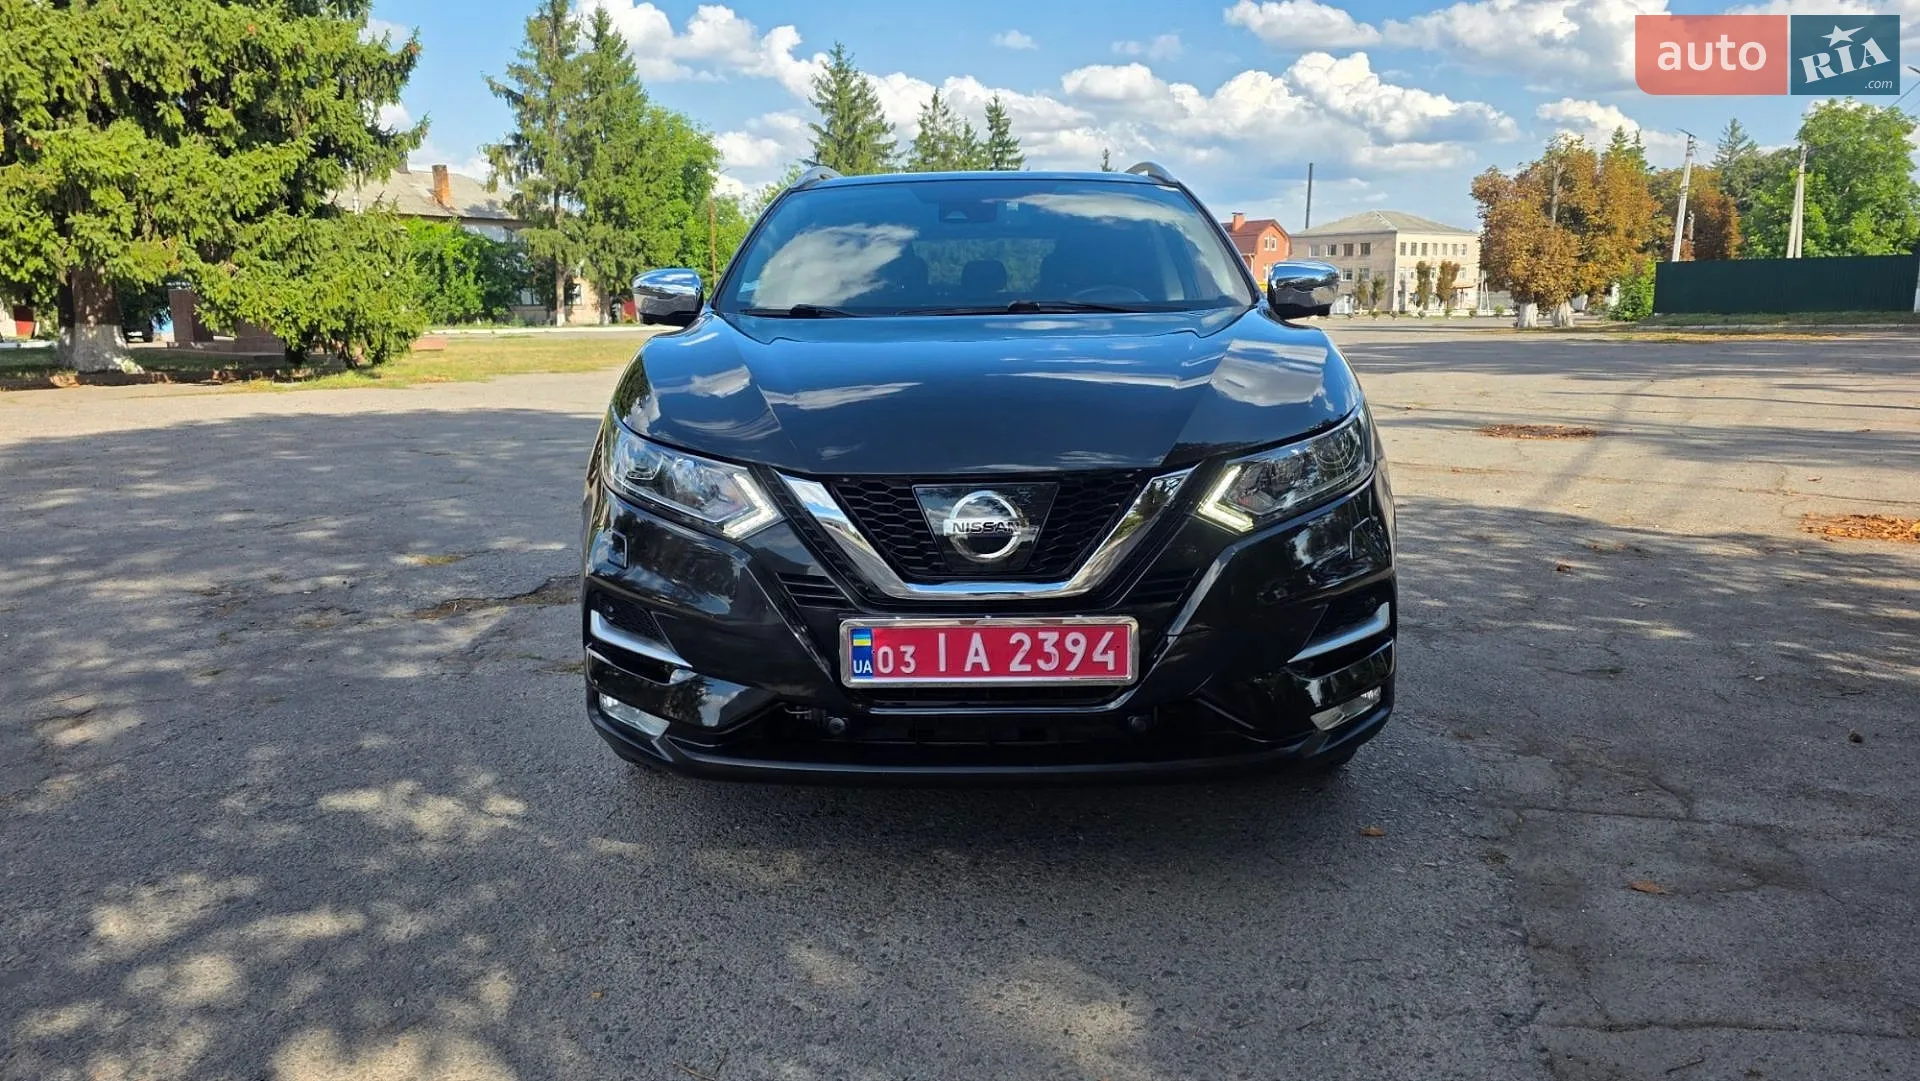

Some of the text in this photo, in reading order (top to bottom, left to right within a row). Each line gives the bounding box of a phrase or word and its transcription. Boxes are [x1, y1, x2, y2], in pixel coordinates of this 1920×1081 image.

[952, 521, 1020, 534] NISSAN
[877, 631, 1115, 674] 03 IA 2394
[853, 660, 872, 674] UA
